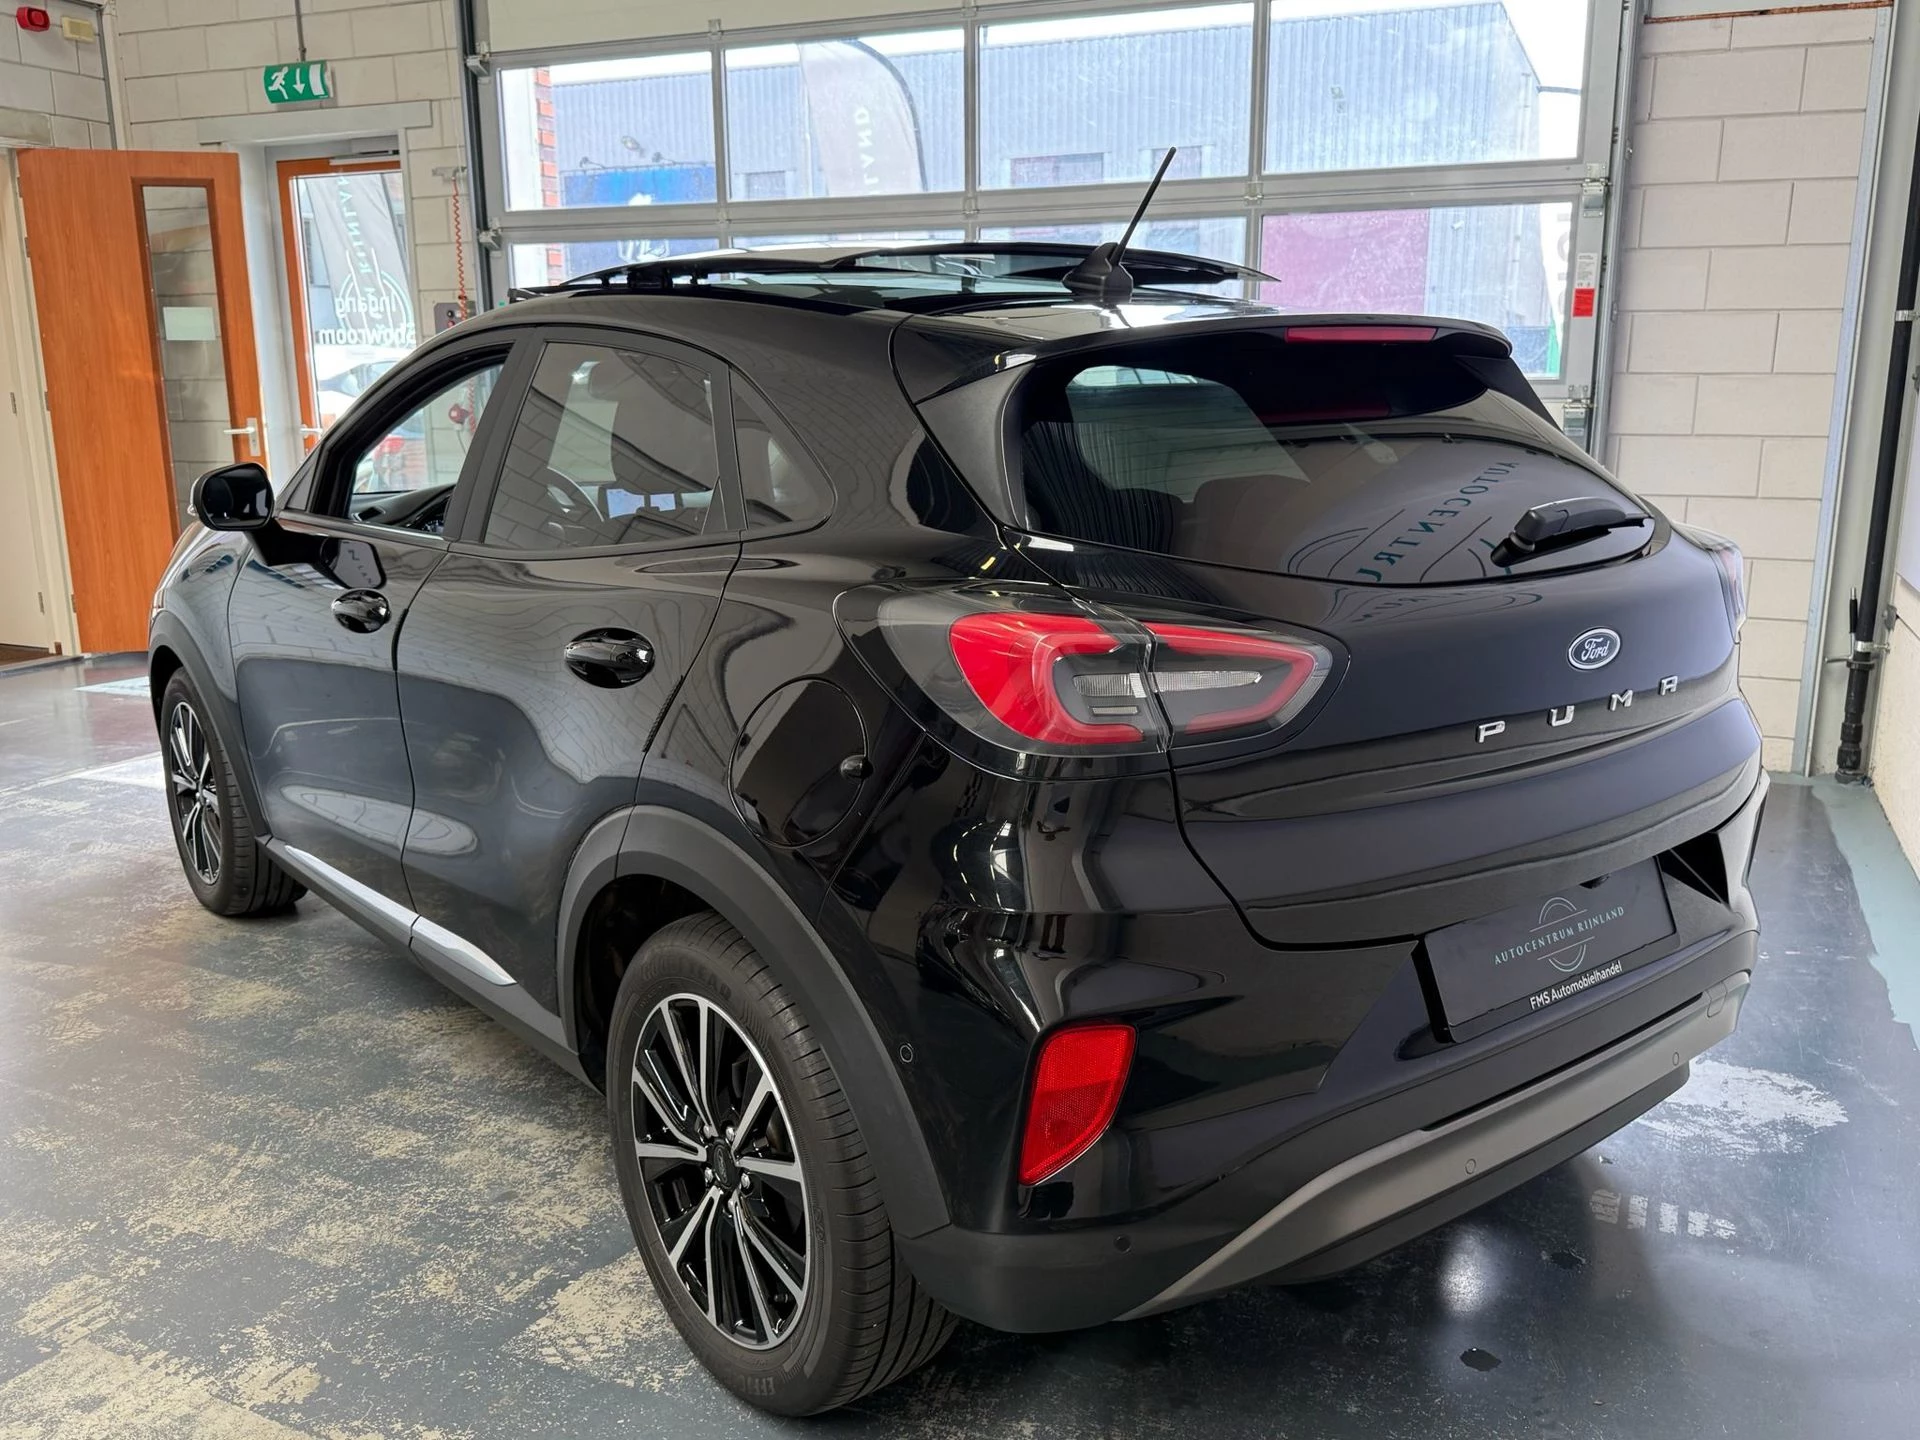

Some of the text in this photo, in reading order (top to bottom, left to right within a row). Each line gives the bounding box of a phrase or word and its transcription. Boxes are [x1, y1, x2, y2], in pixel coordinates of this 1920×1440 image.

[1581, 638, 1611, 661] Ford
[1476, 675, 1679, 743] PUMA
[1494, 906, 1625, 965] AUTOCENTRUM RIJNLAND
[1530, 960, 1623, 1010] FMS Automobielhandel
